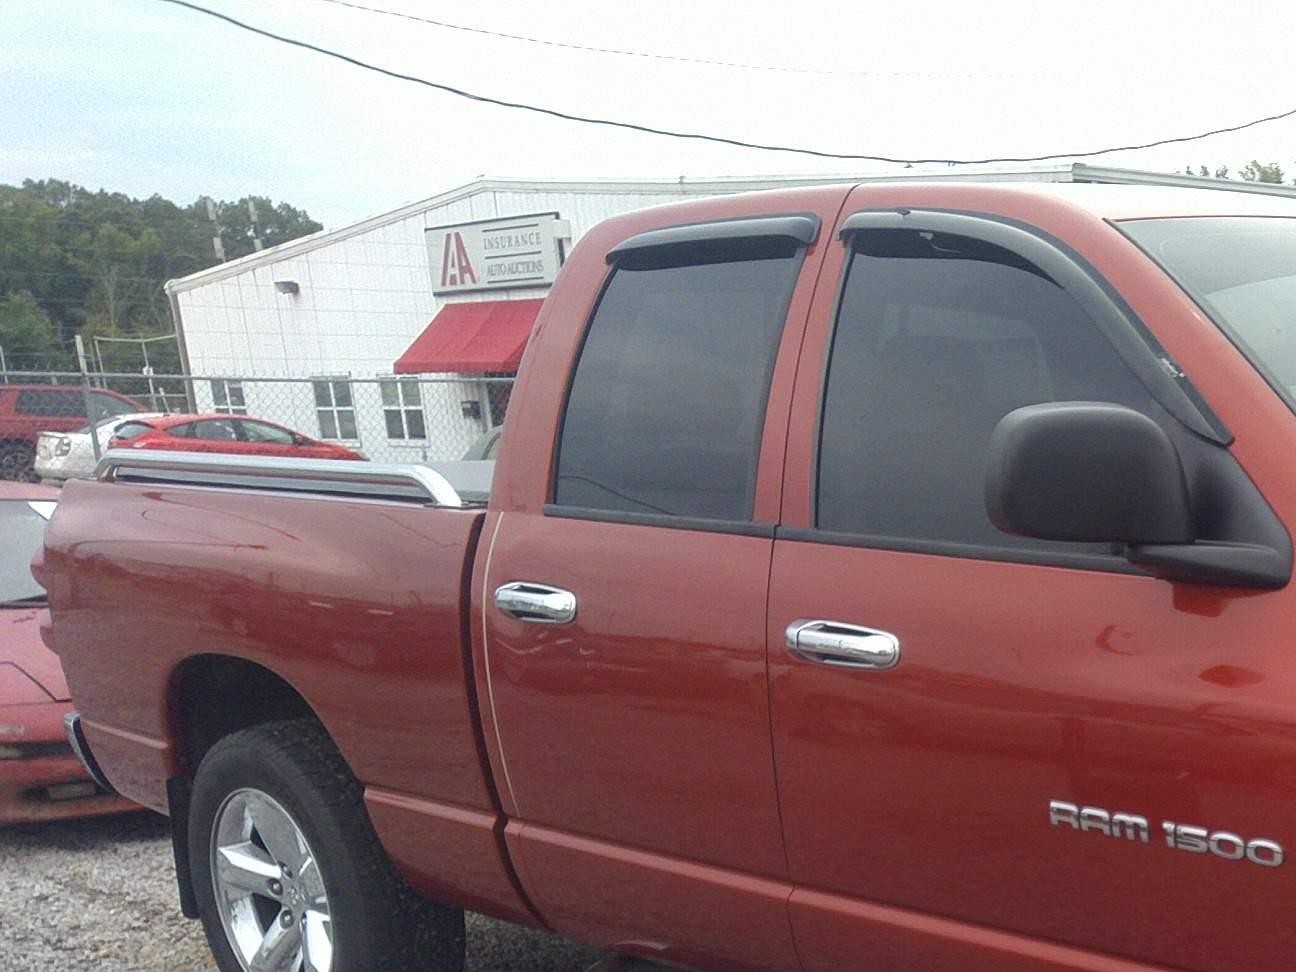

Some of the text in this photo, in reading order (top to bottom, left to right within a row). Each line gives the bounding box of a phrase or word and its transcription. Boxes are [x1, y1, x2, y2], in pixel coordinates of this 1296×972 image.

[483, 231, 542, 250] INSURANCE
[1049, 800, 1285, 867] RAM 1500
